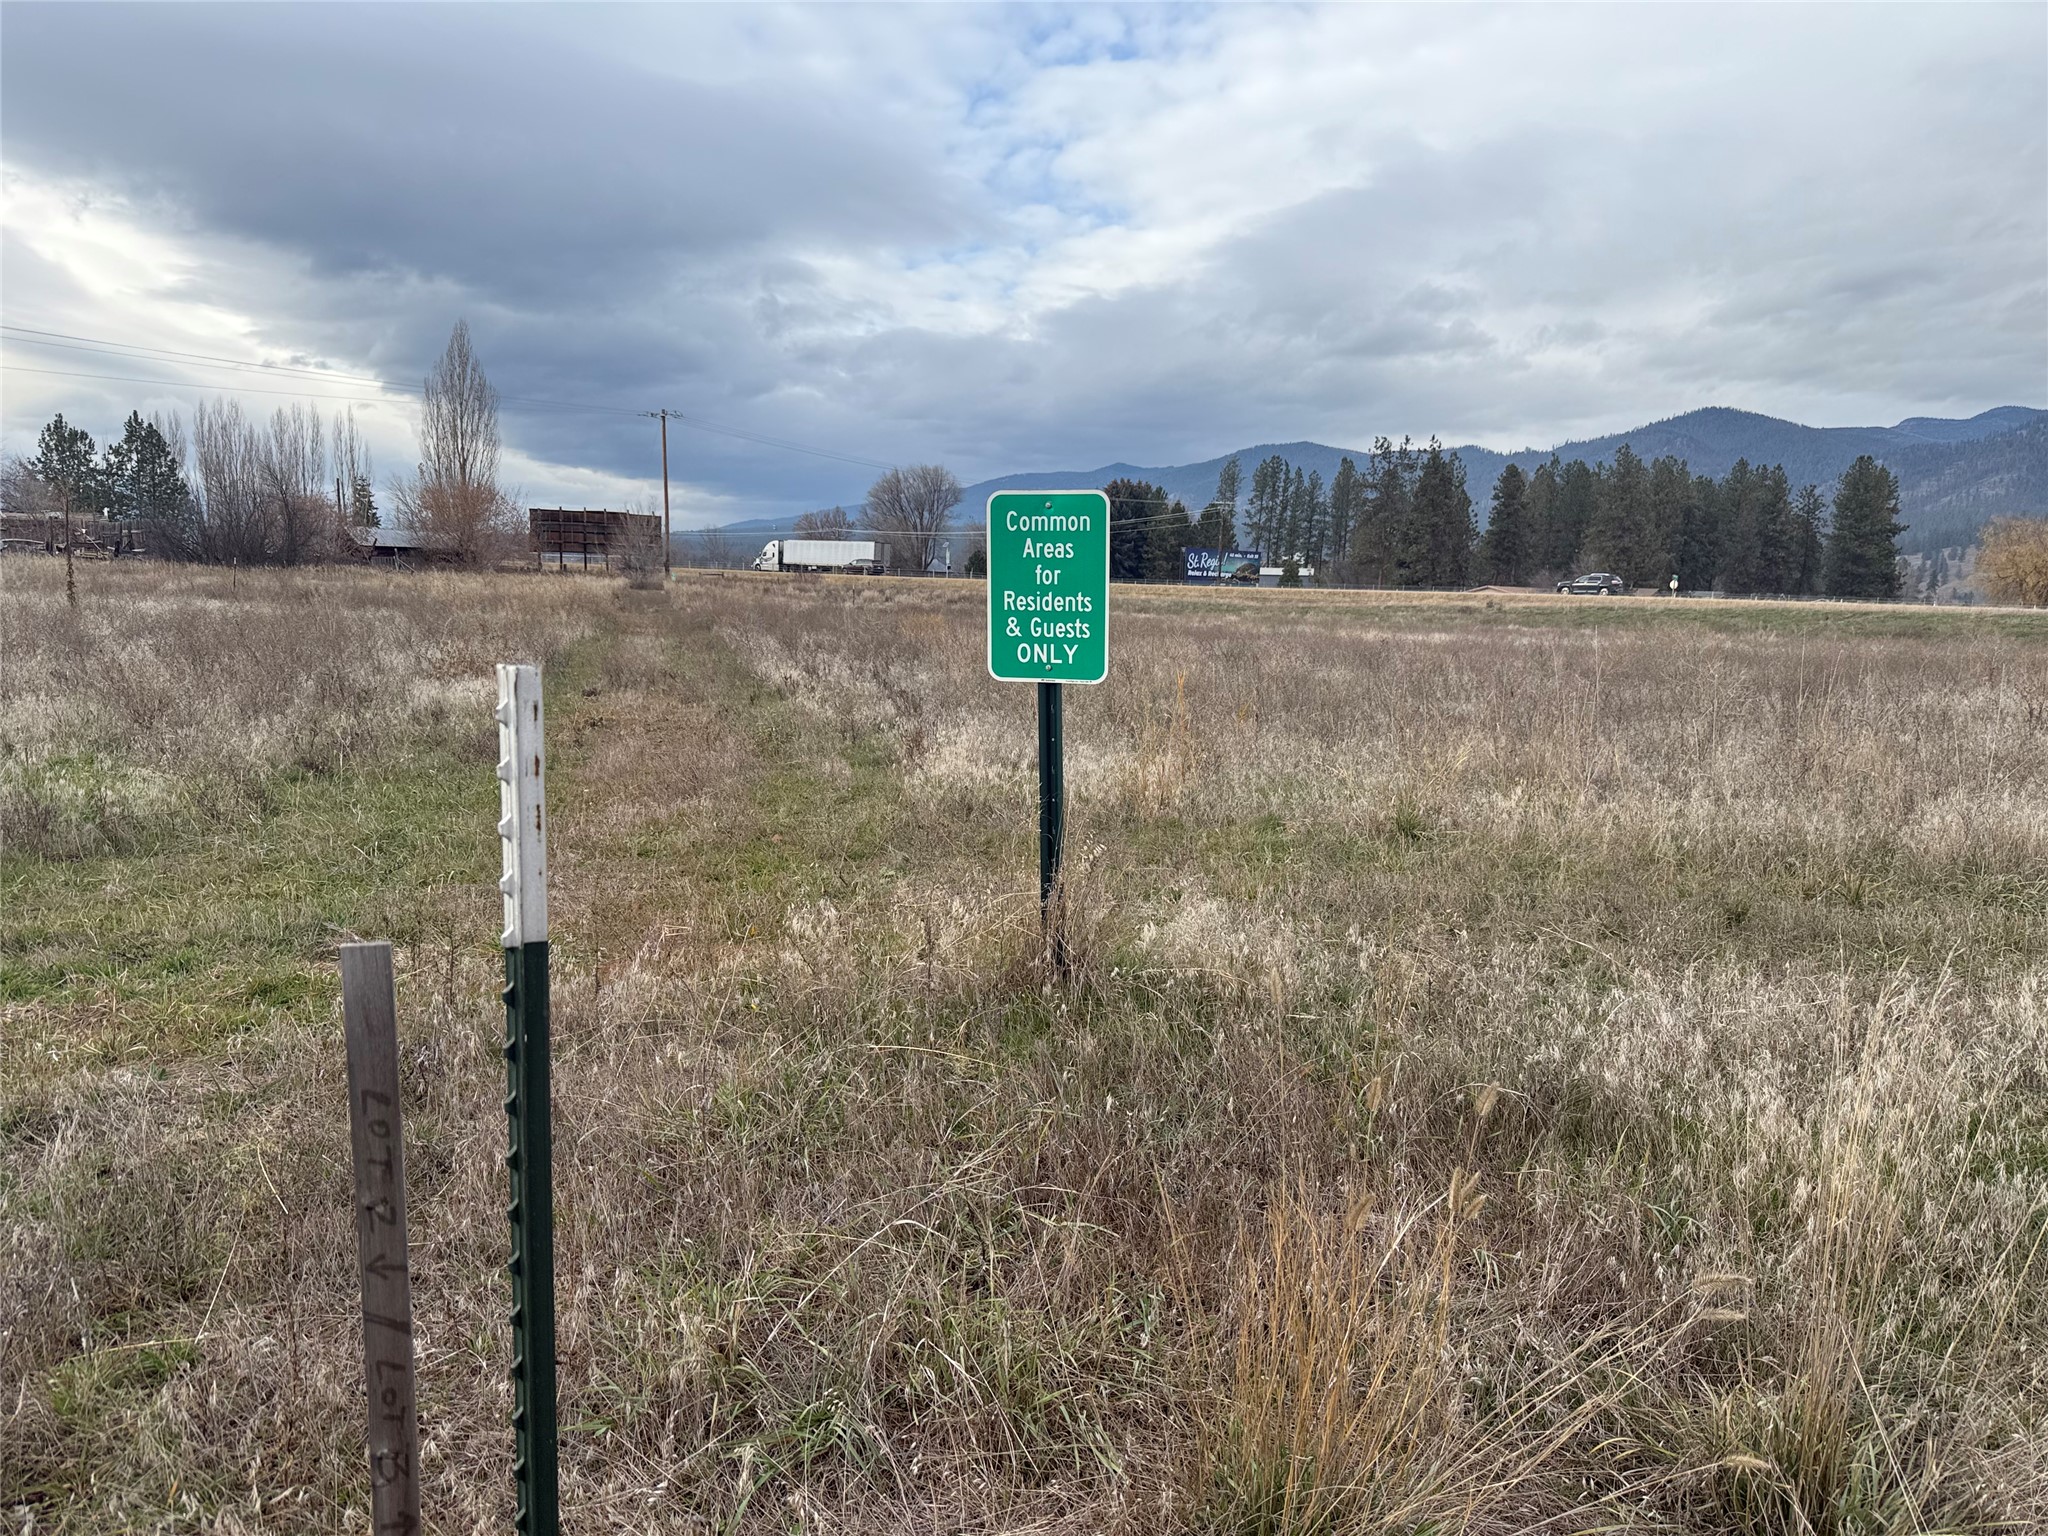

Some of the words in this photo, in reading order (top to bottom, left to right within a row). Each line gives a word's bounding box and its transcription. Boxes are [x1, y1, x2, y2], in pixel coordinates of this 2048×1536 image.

[1006, 510, 1091, 532] Common
[1022, 537, 1075, 559] Areas
[1200, 551, 1228, 571] Regi!
[1035, 564, 1061, 585] for
[1003, 590, 1093, 613] Residents
[1006, 616, 1022, 637] &
[1030, 617, 1091, 639] Guests
[1017, 643, 1079, 664] ONLY
[361, 1089, 394, 1183] LOT
